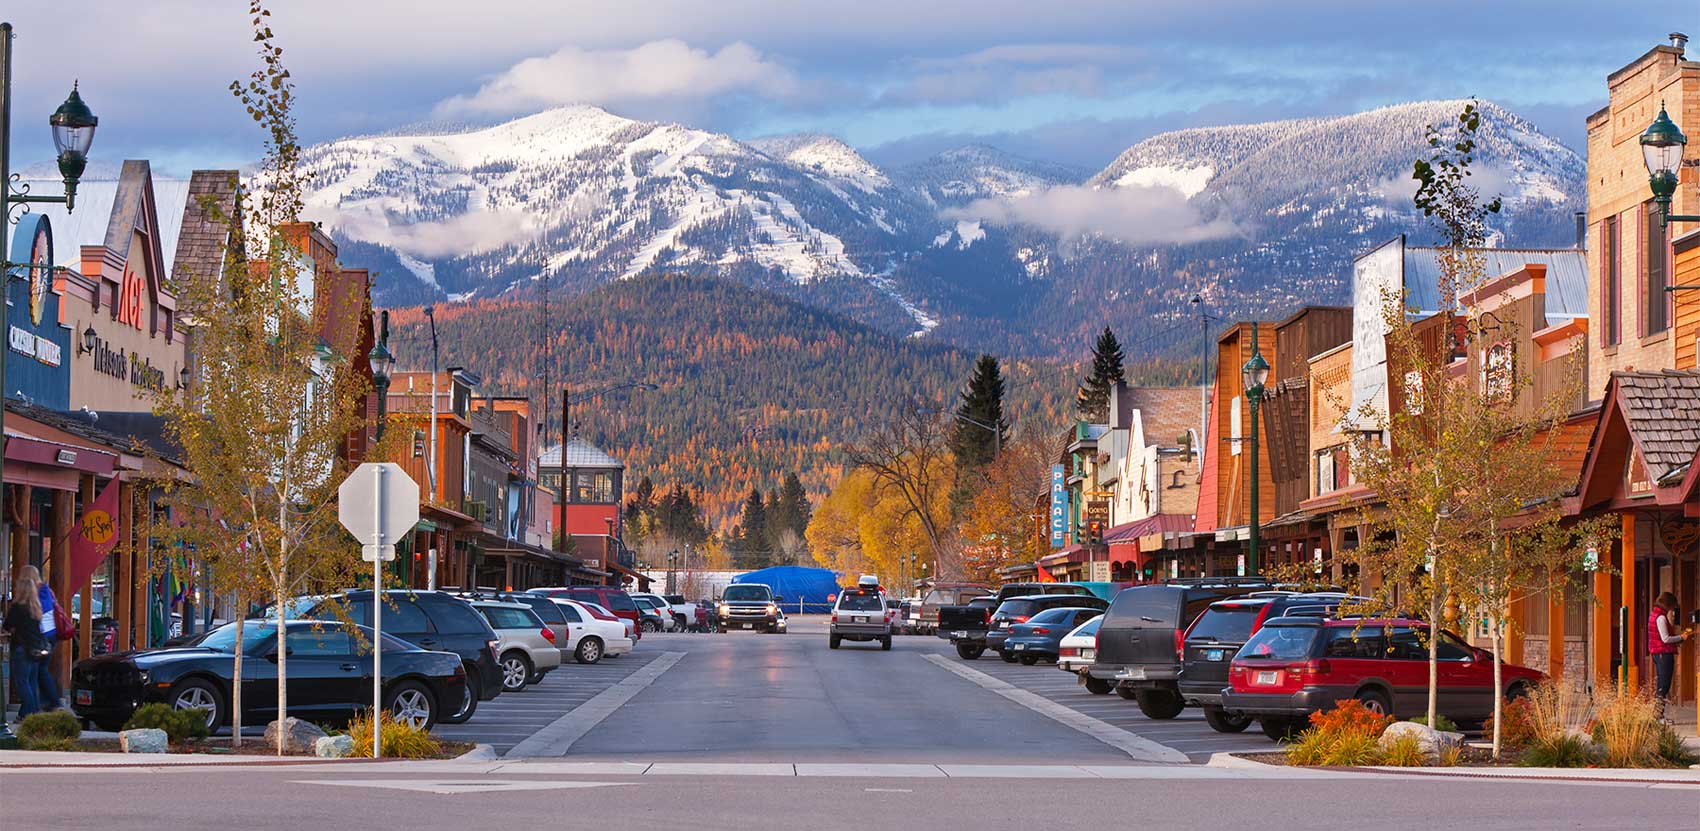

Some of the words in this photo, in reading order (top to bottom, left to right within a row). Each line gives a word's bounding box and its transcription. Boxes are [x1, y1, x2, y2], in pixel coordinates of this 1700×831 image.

[118, 260, 145, 331] ACE
[94, 336, 128, 381] Nelson's
[80, 519, 96, 541] Art
[95, 515, 116, 539] Spot
[1053, 471, 1063, 540] PALACE
